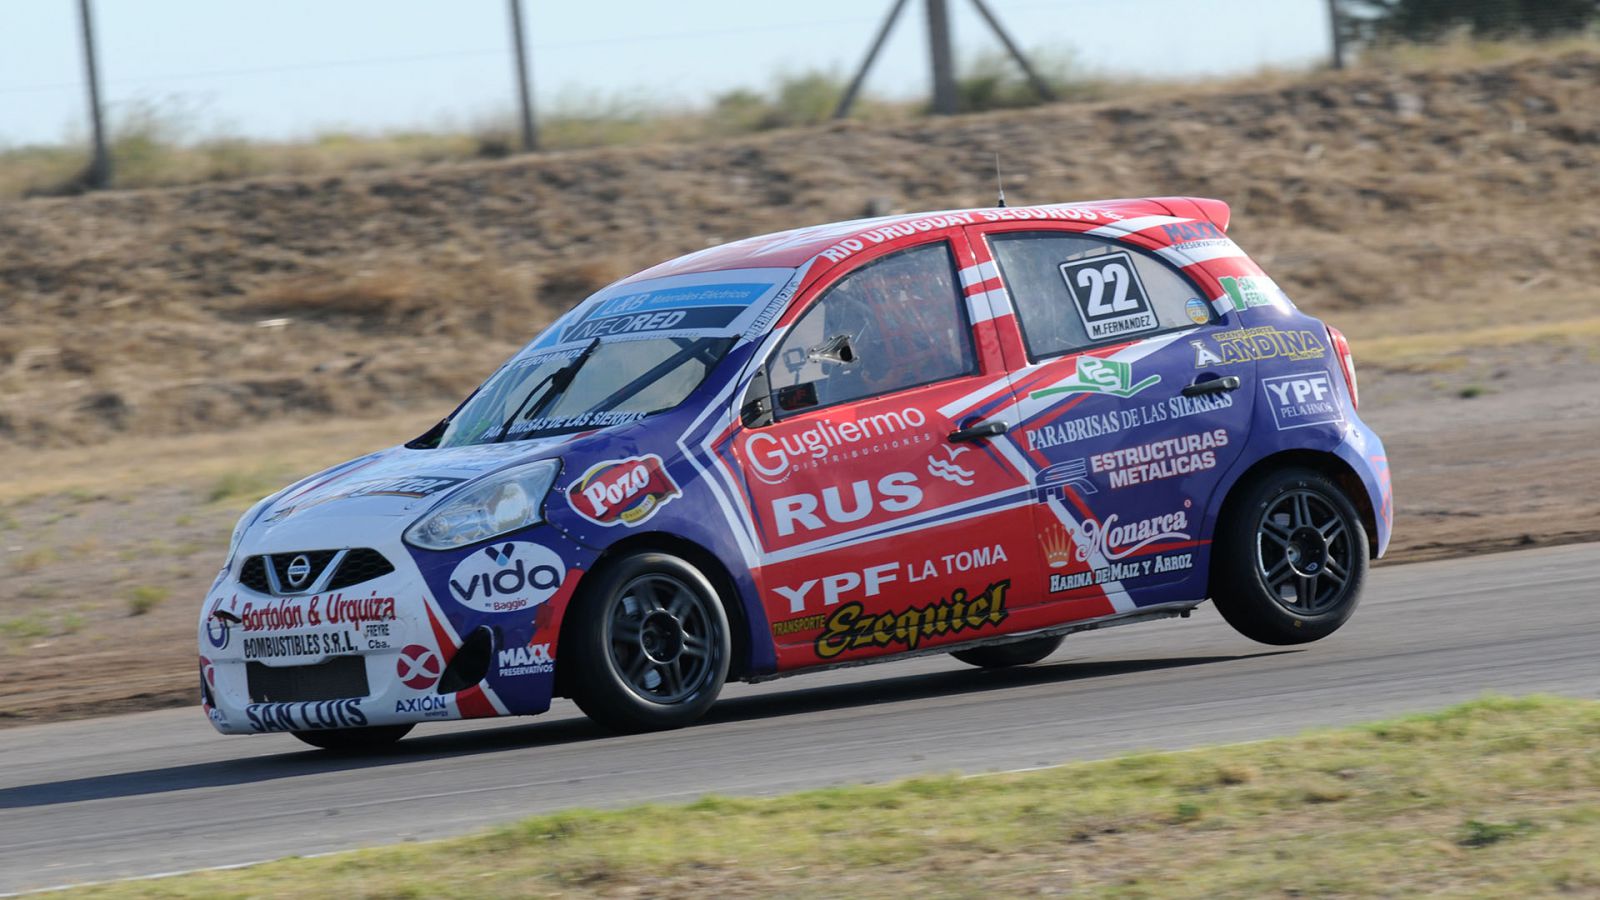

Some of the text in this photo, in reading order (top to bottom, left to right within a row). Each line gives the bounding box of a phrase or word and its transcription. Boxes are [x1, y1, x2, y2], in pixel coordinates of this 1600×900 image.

[823, 207, 1101, 264] RIO URUGUAY SEGUROS
[1161, 221, 1225, 243] MAXX
[604, 293, 650, 314] L&B
[1076, 262, 1139, 318] 22
[573, 310, 687, 340] NEORED
[1091, 315, 1152, 336] M.FERNANDEZ
[1220, 331, 1325, 364] ANDINA
[1267, 377, 1329, 406] YPF
[546, 416, 568, 430] DE
[566, 414, 591, 428] LAS
[592, 411, 648, 427] SIERRAS
[1026, 411, 1120, 451] PARABRISAS
[1121, 408, 1140, 430] DE
[1142, 402, 1167, 424] LAS
[744, 407, 926, 476] Gugliermo
[793, 432, 931, 472] DISTRIBUCIONES
[1089, 429, 1229, 473] ESTRUCTURAS
[1108, 452, 1217, 490] METALICAS
[771, 471, 924, 537] RUS
[1075, 510, 1192, 562] Monarca
[450, 559, 562, 601] vida
[771, 544, 1008, 614] YPF LA TOMA
[1141, 560, 1151, 575] Y
[307, 595, 323, 627] &
[493, 597, 527, 611] Baggio
[814, 578, 1012, 660] Ezequiel
[366, 624, 390, 637] FREYRE
[772, 615, 827, 636] TRANSPORTE
[244, 629, 359, 659] COMBUSTIBLES S.R.L.
[368, 639, 391, 649] Cba.
[498, 643, 553, 667] MAXX
[499, 664, 554, 677] PRESERVATIVOS
[246, 703, 302, 733] SAN
[301, 697, 369, 731] LUIS
[395, 695, 446, 713] AXIÓN
